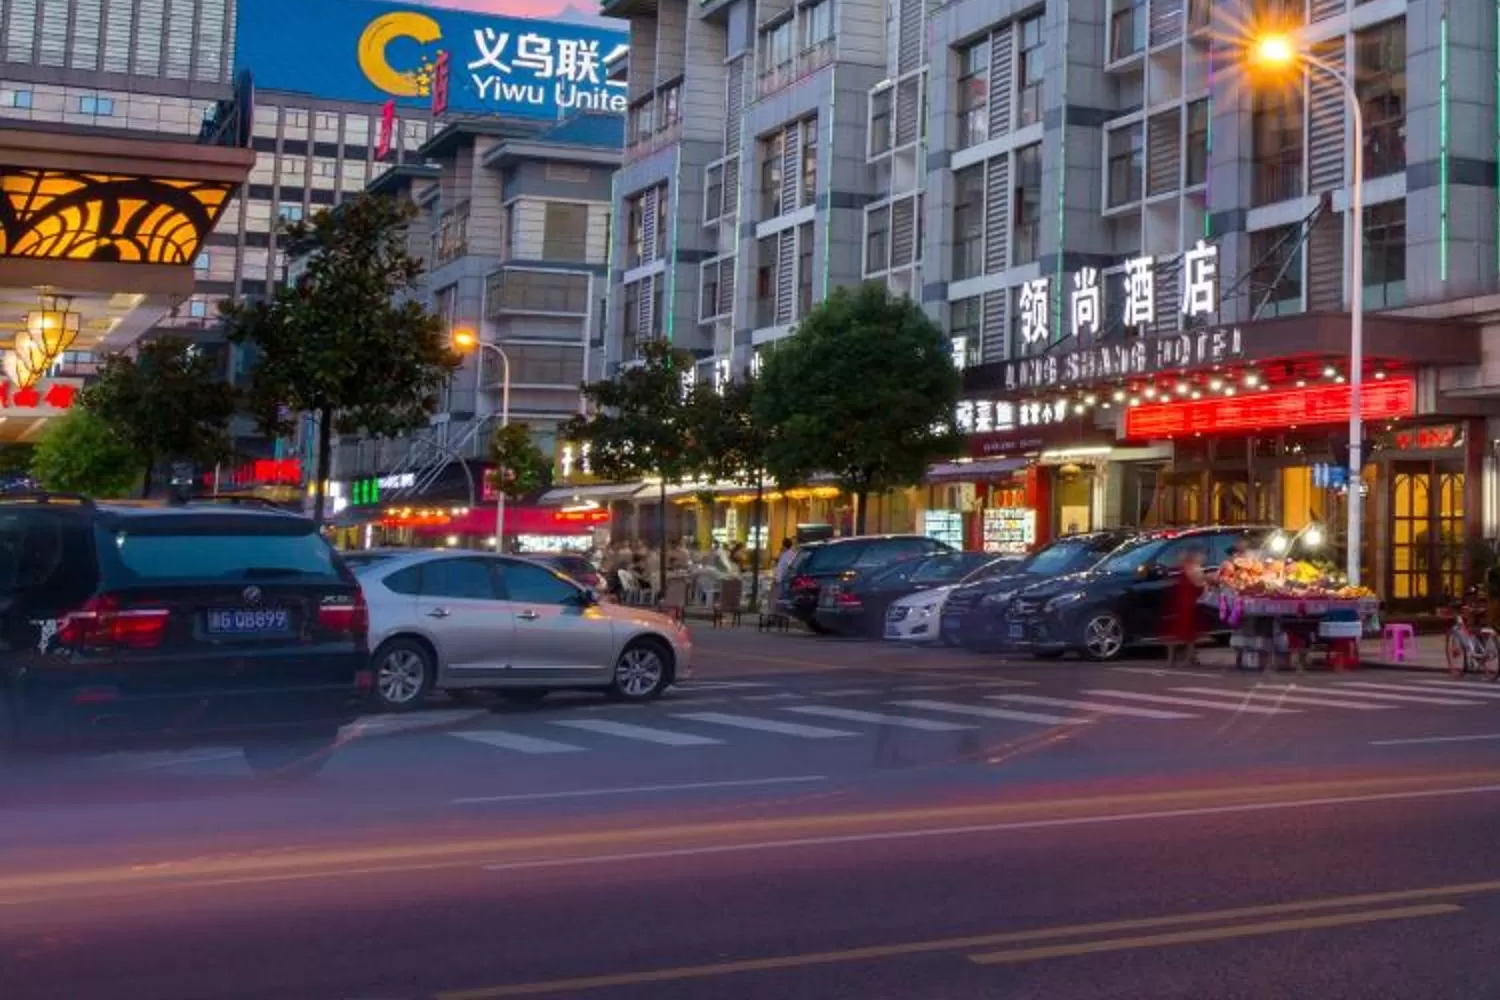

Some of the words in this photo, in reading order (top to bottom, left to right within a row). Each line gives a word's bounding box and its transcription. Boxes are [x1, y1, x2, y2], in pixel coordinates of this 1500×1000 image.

[471, 74, 543, 105] Yiwu
[1019, 239, 1218, 344] 领尚酒店
